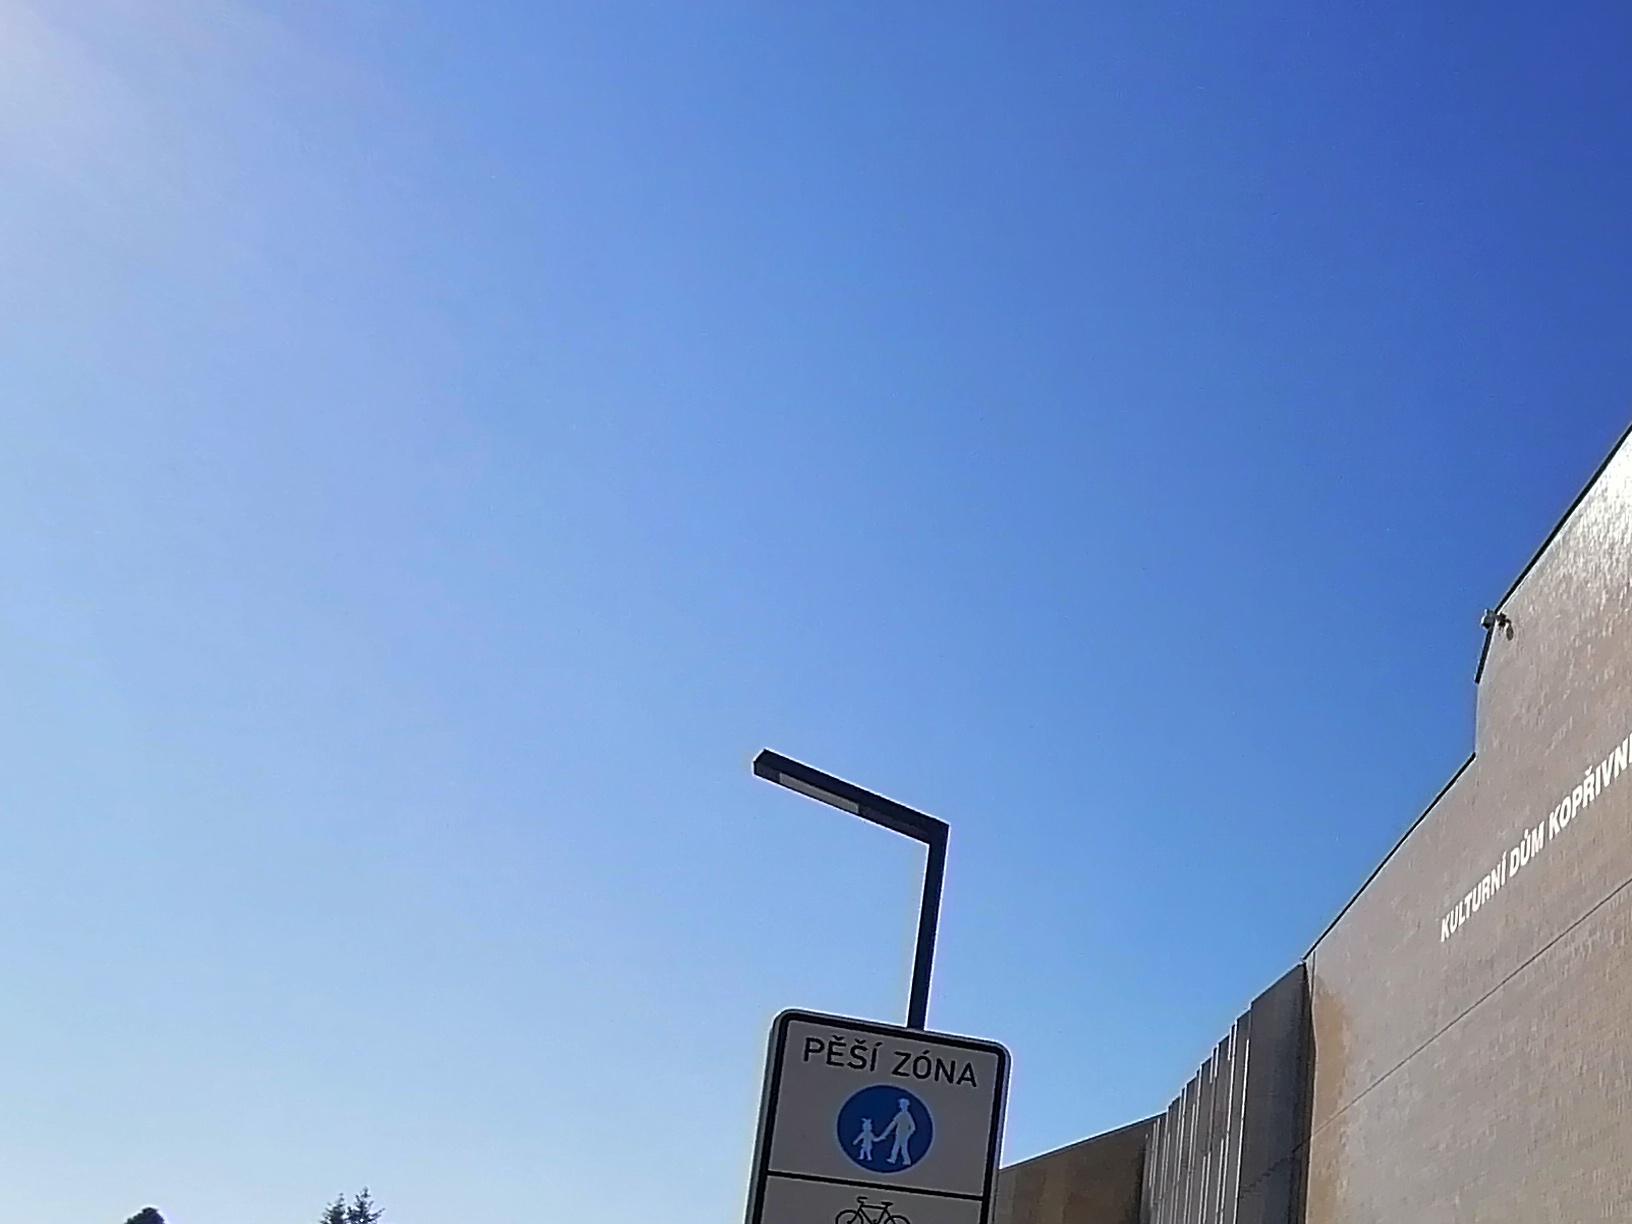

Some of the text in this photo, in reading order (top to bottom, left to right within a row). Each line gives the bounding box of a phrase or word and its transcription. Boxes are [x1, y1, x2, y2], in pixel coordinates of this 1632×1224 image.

[1440, 850, 1507, 943] KULTURNÍ
[1509, 820, 1545, 878] DŮM
[803, 1034, 977, 1088] PĚŠÍ ZÓNA
